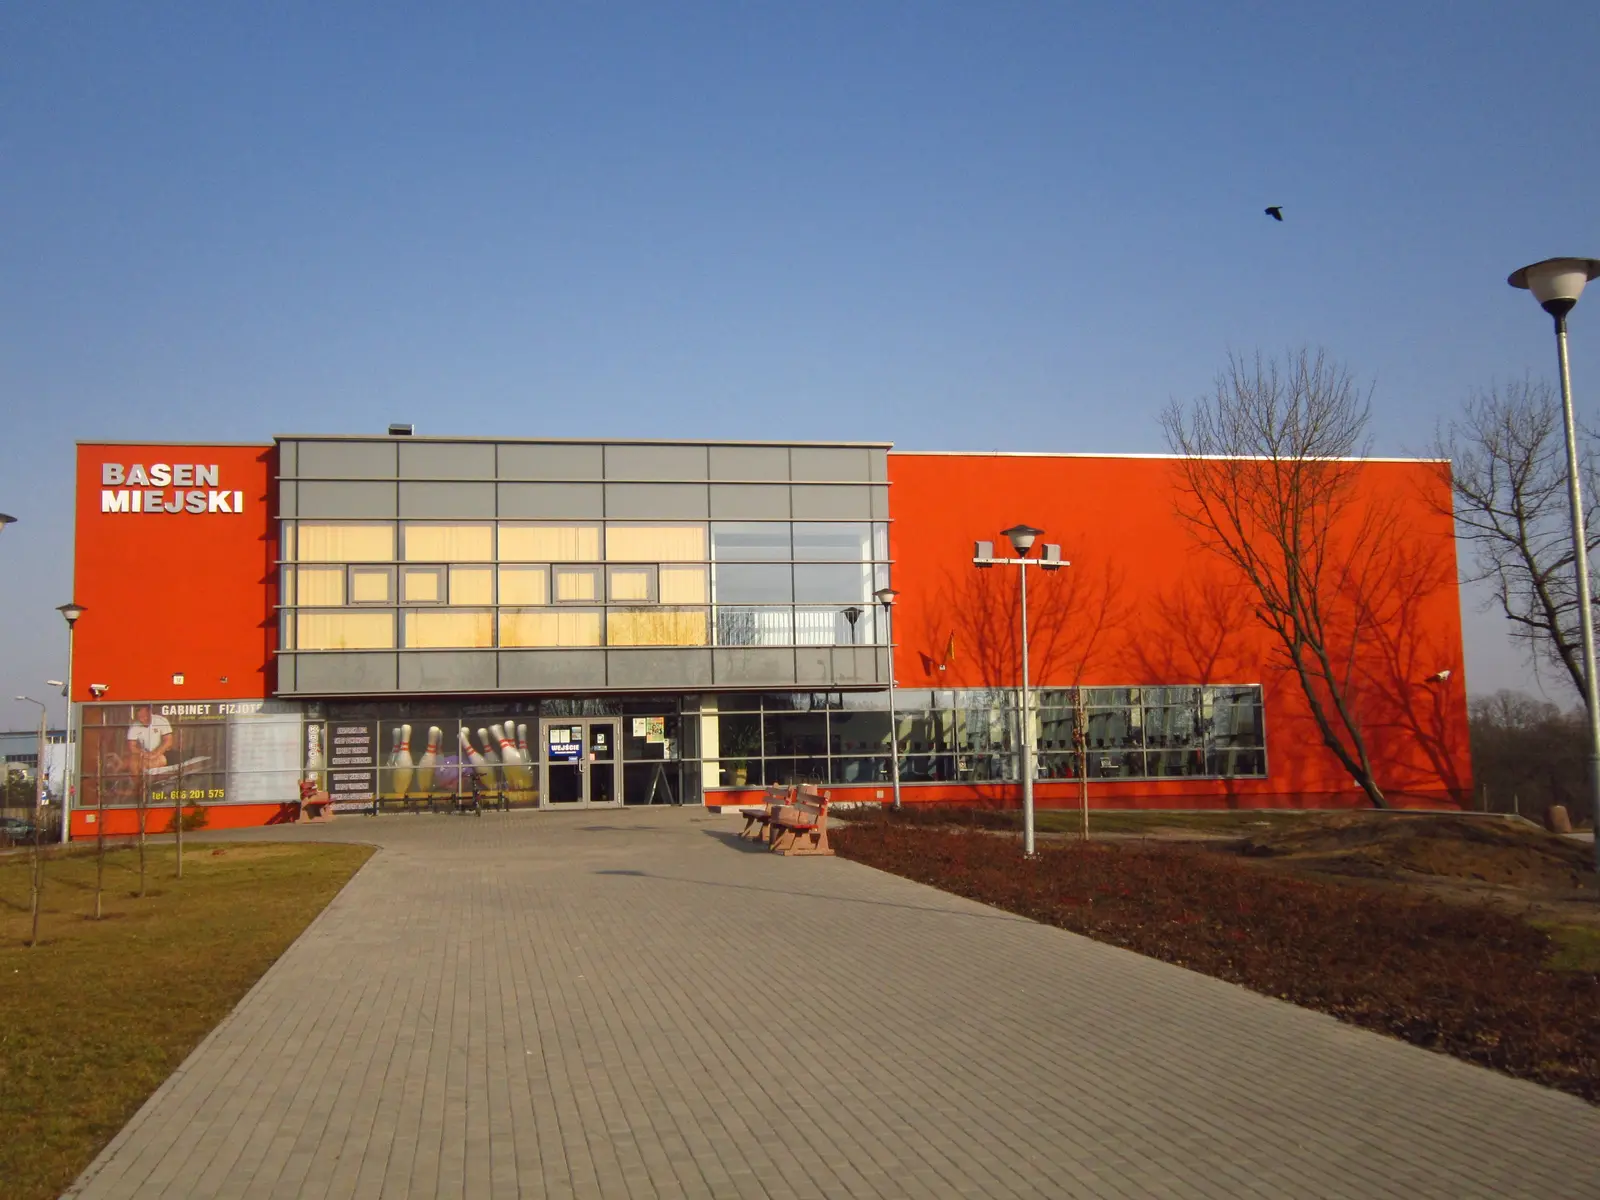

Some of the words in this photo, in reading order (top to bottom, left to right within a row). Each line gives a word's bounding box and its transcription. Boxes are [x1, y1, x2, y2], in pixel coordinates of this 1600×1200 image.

[102, 463, 219, 487] BASEN
[101, 490, 243, 513] MIEJSKI
[161, 704, 211, 716] GABINET
[152, 791, 167, 800] tel.
[189, 789, 205, 799] 201
[208, 788, 225, 798] 575
